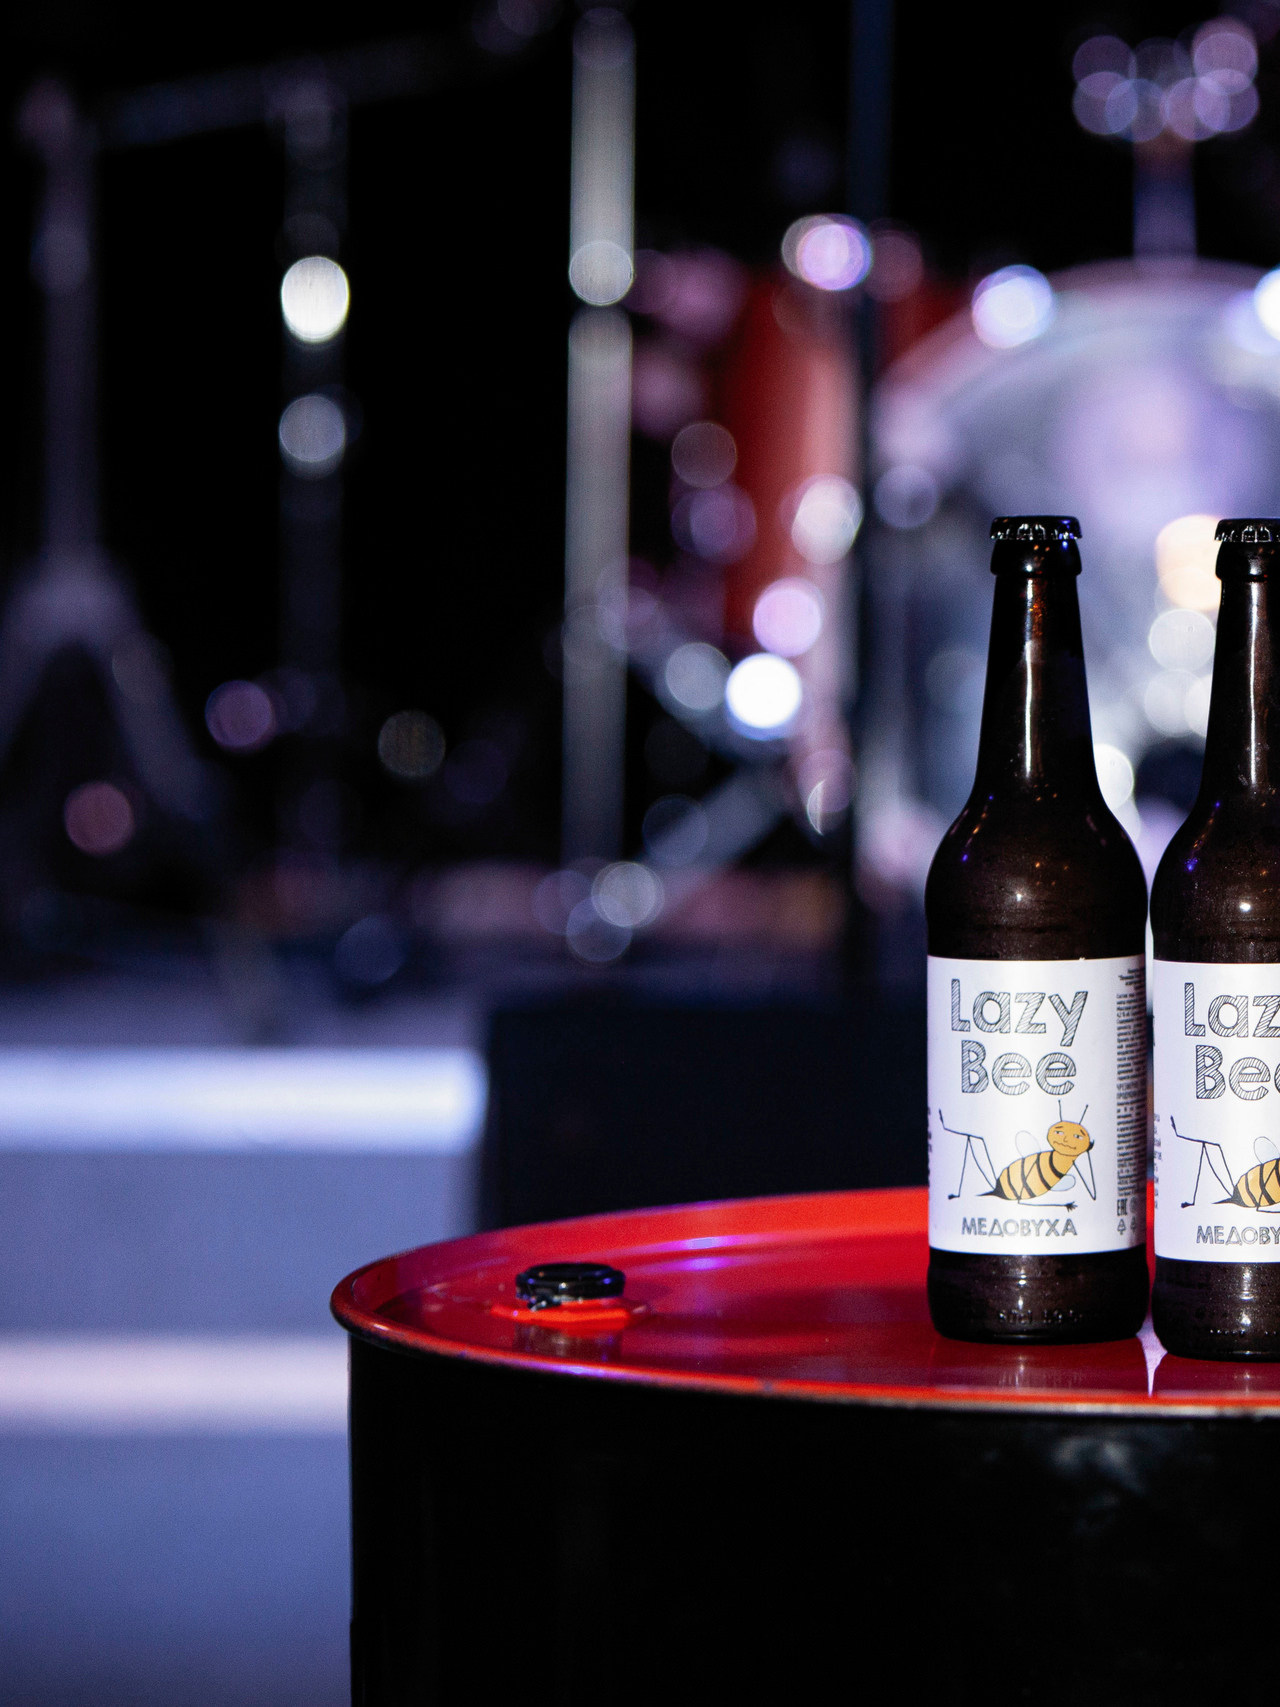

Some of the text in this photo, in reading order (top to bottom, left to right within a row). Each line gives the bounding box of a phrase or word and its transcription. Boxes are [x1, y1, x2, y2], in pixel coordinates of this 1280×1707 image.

[950, 978, 1089, 1047] Lazy
[960, 1039, 1078, 1096] Bee
[961, 1217, 1078, 1237] МЕДОВУХА
